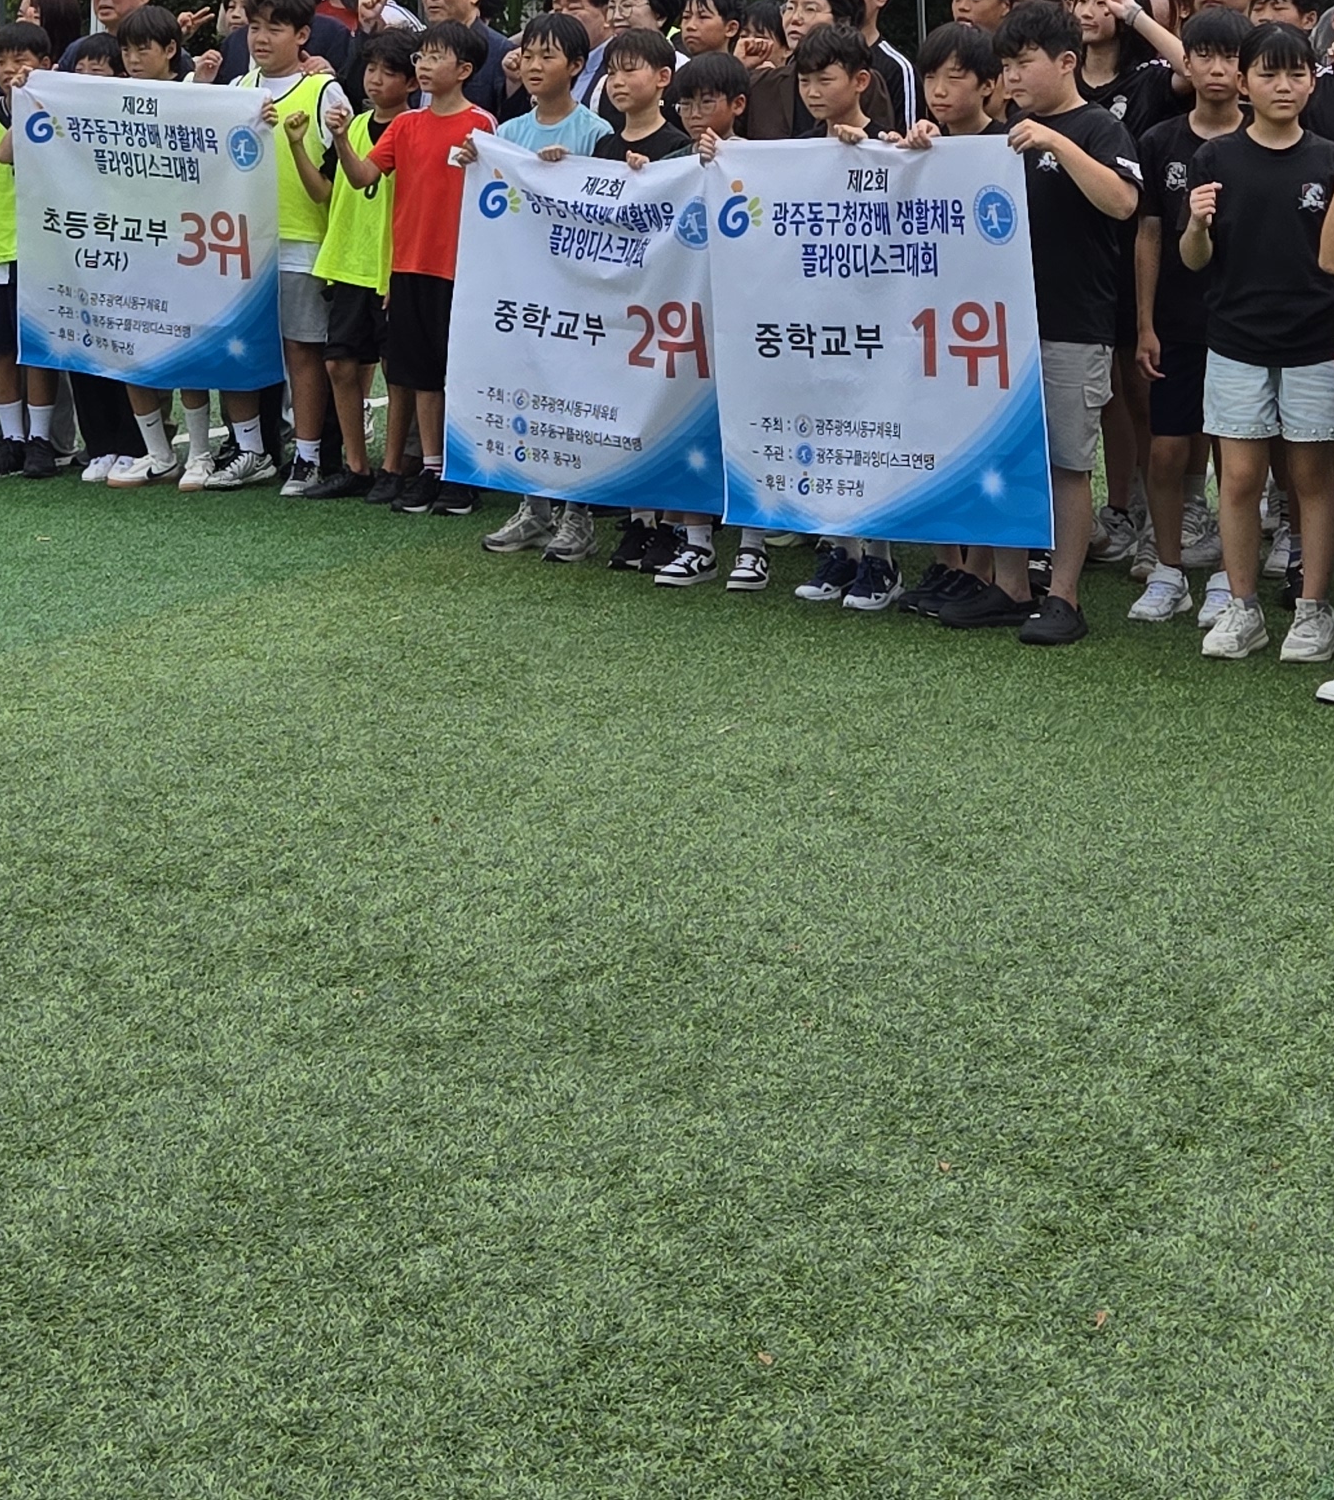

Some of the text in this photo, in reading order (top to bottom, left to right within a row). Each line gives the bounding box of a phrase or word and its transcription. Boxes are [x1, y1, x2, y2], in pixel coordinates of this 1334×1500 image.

[122, 95, 158, 117] 제2회
[66, 116, 219, 154] 광주동구청장배 생활체육
[94, 149, 200, 184] 플라잉디스크대회
[847, 167, 889, 193] 제2회
[580, 176, 627, 200] 제2회
[616, 201, 675, 234] 생활체육
[771, 197, 966, 237] 광주동구청장배 생활체육
[43, 207, 252, 280] 초등학교부 3위
[74, 247, 129, 272] (남자)
[800, 241, 939, 279] 플라잉디스크대회
[493, 299, 711, 379] 중학교부 2위
[754, 300, 1010, 390] 중학교부 1위
[815, 418, 902, 440] 광주광역시동구체육회
